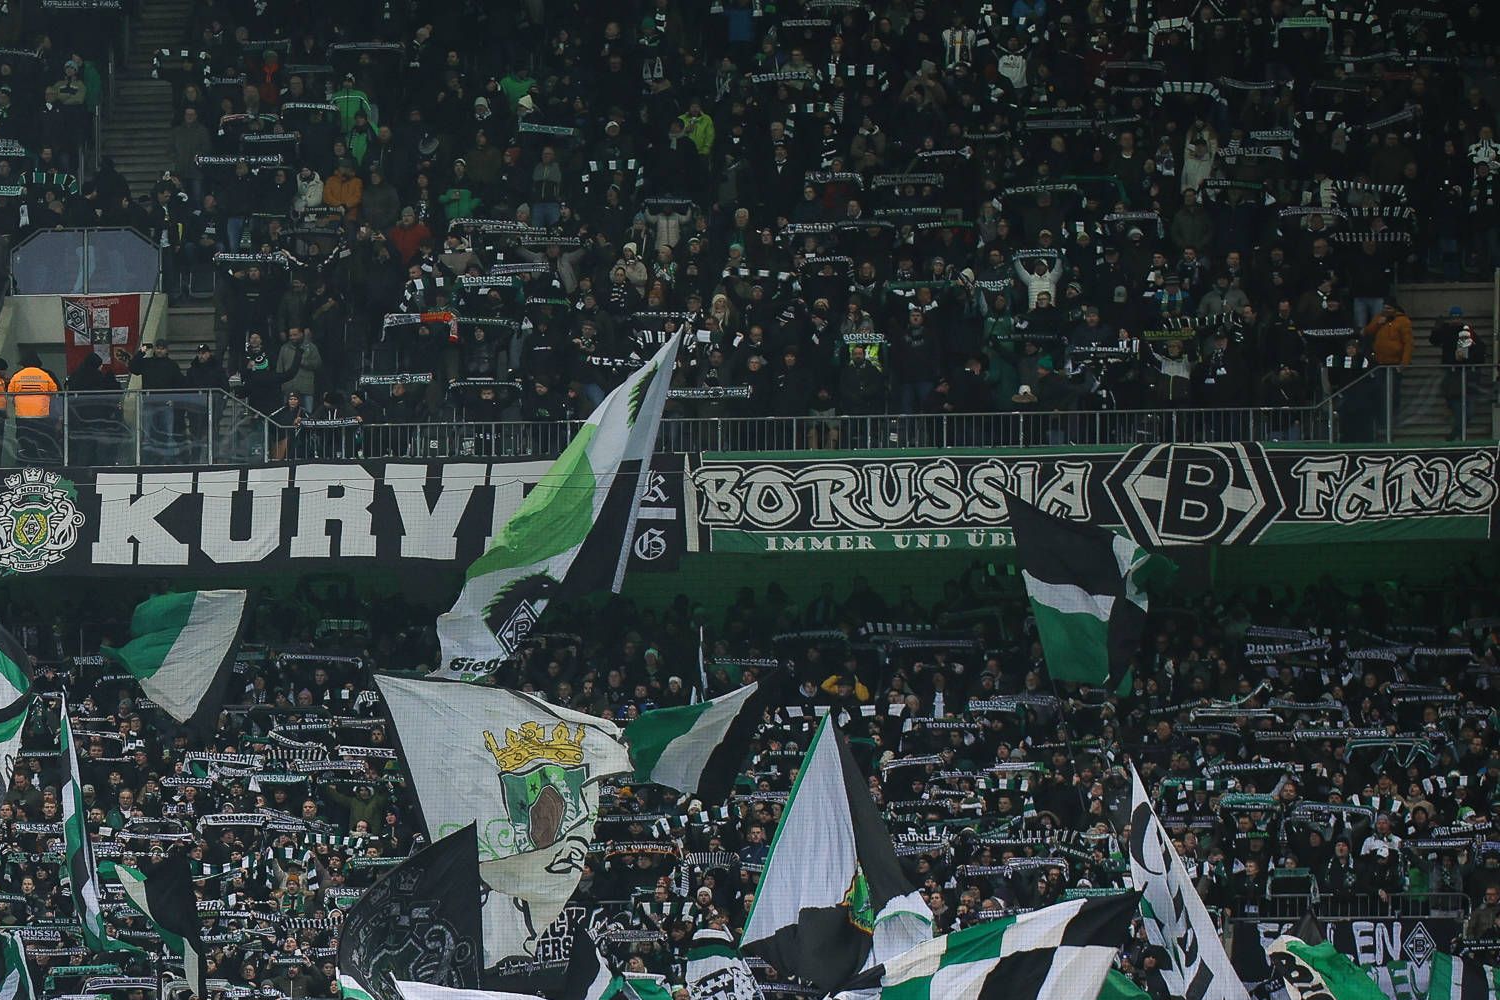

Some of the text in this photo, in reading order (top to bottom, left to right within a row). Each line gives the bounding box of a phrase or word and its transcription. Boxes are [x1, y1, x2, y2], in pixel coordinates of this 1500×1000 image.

[698, 456, 1092, 527] BORUSSIA
[1295, 452, 1497, 524] FANS
[766, 534, 876, 551] IMMER
[894, 534, 951, 549] UND
